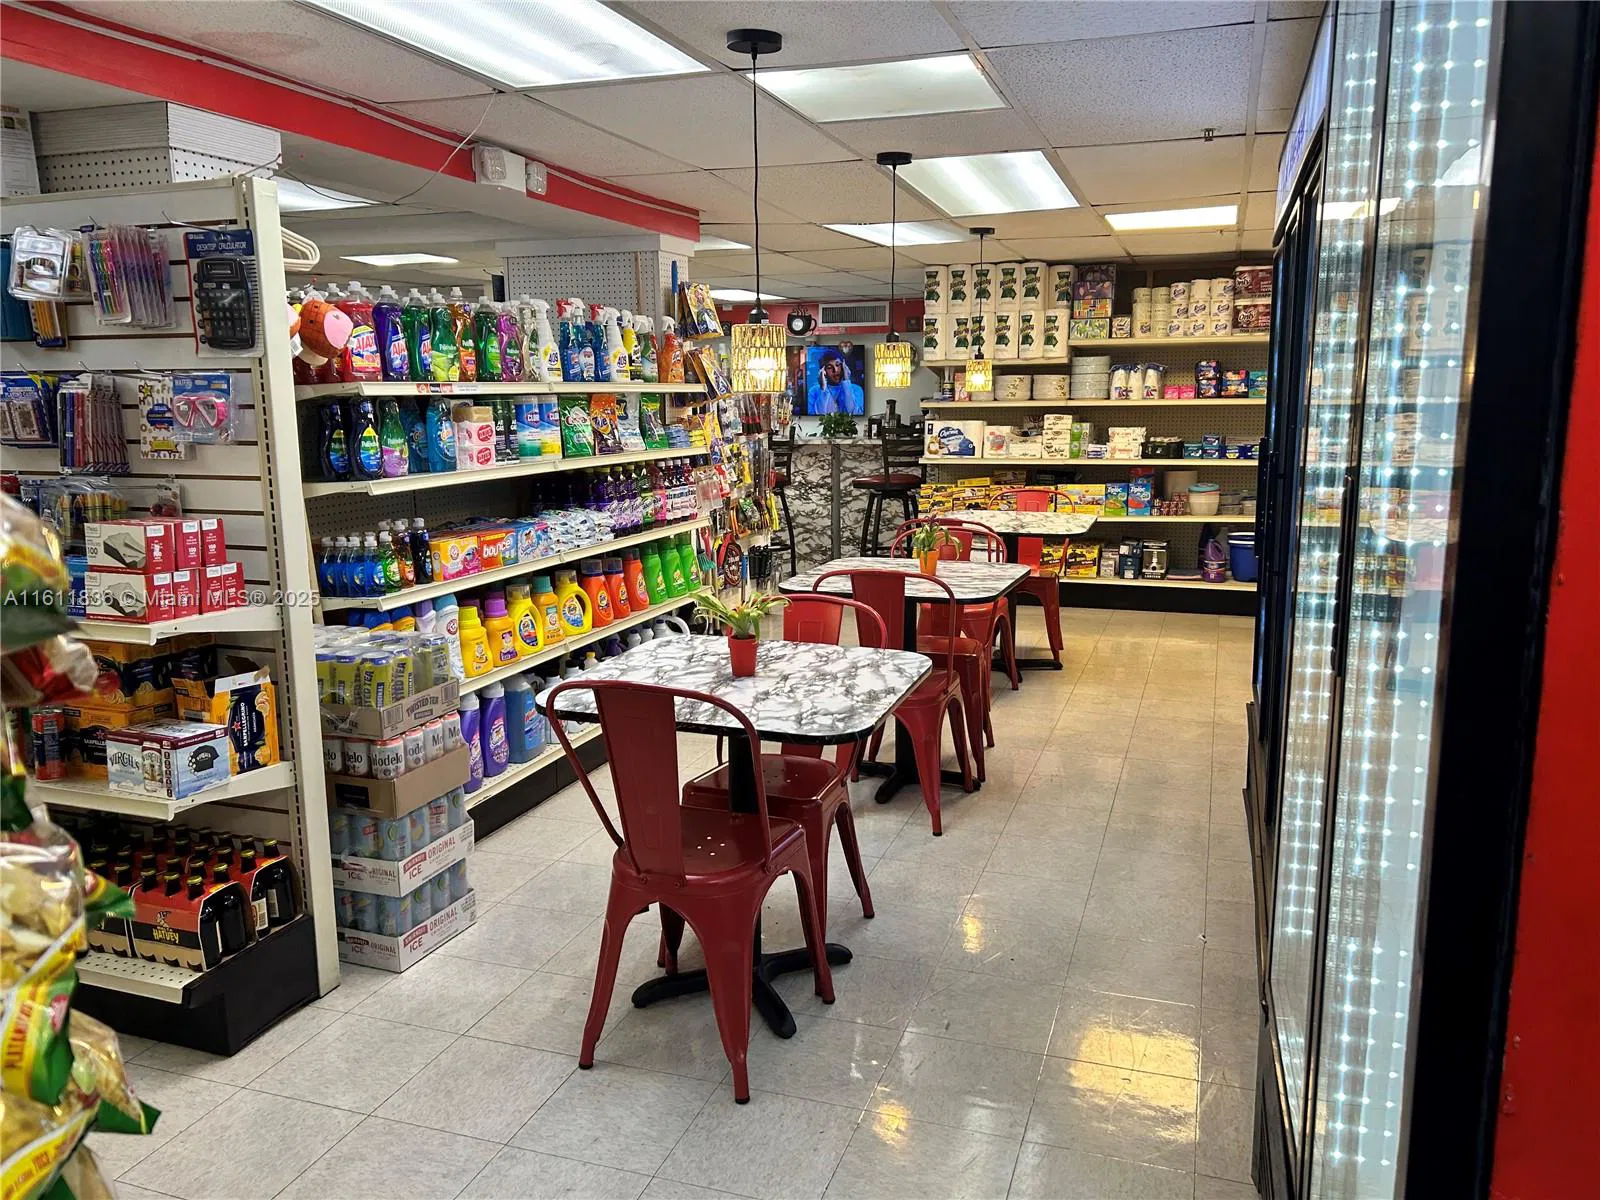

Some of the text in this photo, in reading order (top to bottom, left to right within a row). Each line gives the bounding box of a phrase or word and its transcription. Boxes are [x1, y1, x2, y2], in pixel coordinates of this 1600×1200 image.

[218, 241, 247, 249] CALCULATOR
[355, 334, 375, 352] AJAX
[548, 351, 559, 364] 409
[617, 354, 627, 366] 409
[87, 547, 98, 555] 100
[483, 540, 511, 557] bounce
[406, 695, 439, 716] TWISTED TEA
[109, 751, 140, 770] VIRGIL'S
[427, 836, 456, 859] ORIGINAL
[348, 872, 362, 880] ICE
[409, 864, 423, 880] ICE
[429, 907, 458, 931] ORIGINAL
[152, 928, 179, 944] HATUEY
[351, 946, 364, 954] ICE
[370, 942, 396, 954] ORIGINAL
[409, 938, 423, 953] ICE
